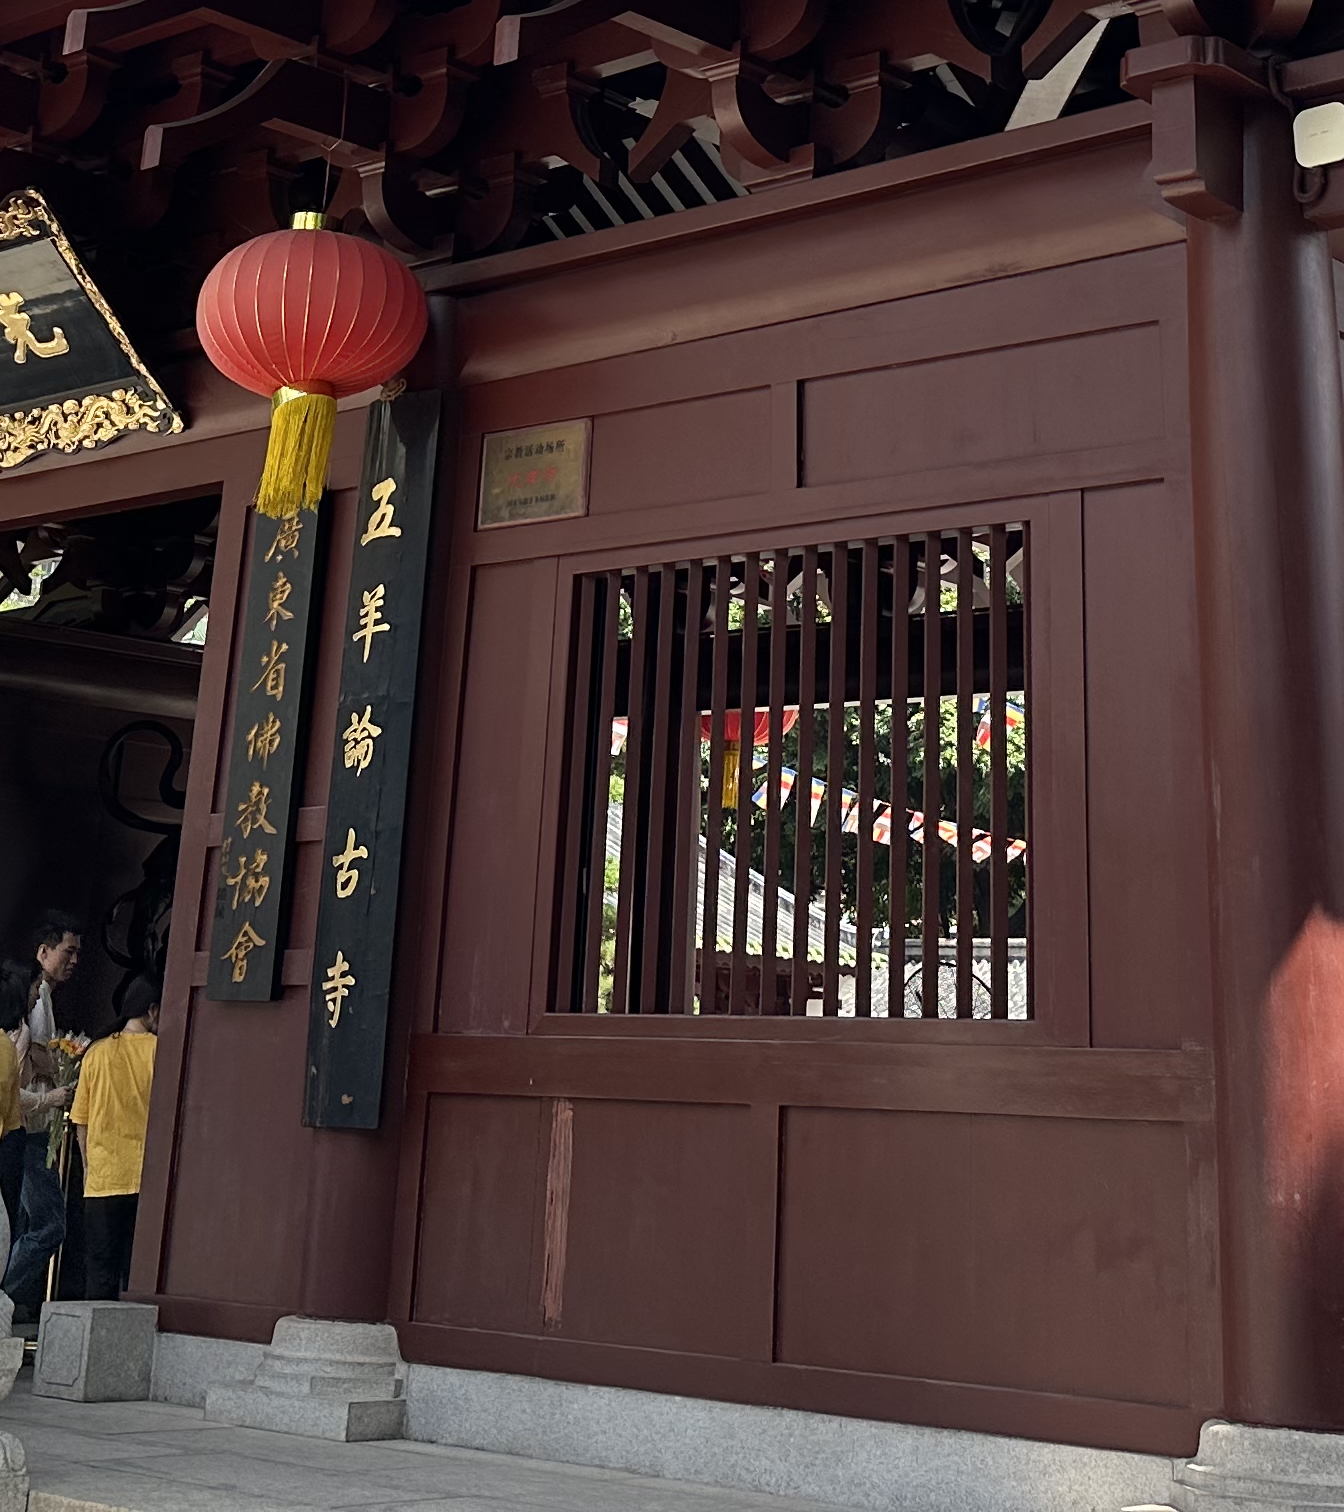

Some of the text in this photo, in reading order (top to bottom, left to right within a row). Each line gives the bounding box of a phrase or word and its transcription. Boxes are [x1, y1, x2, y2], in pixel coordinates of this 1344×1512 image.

[321, 477, 403, 1029] 五羊論古寺
